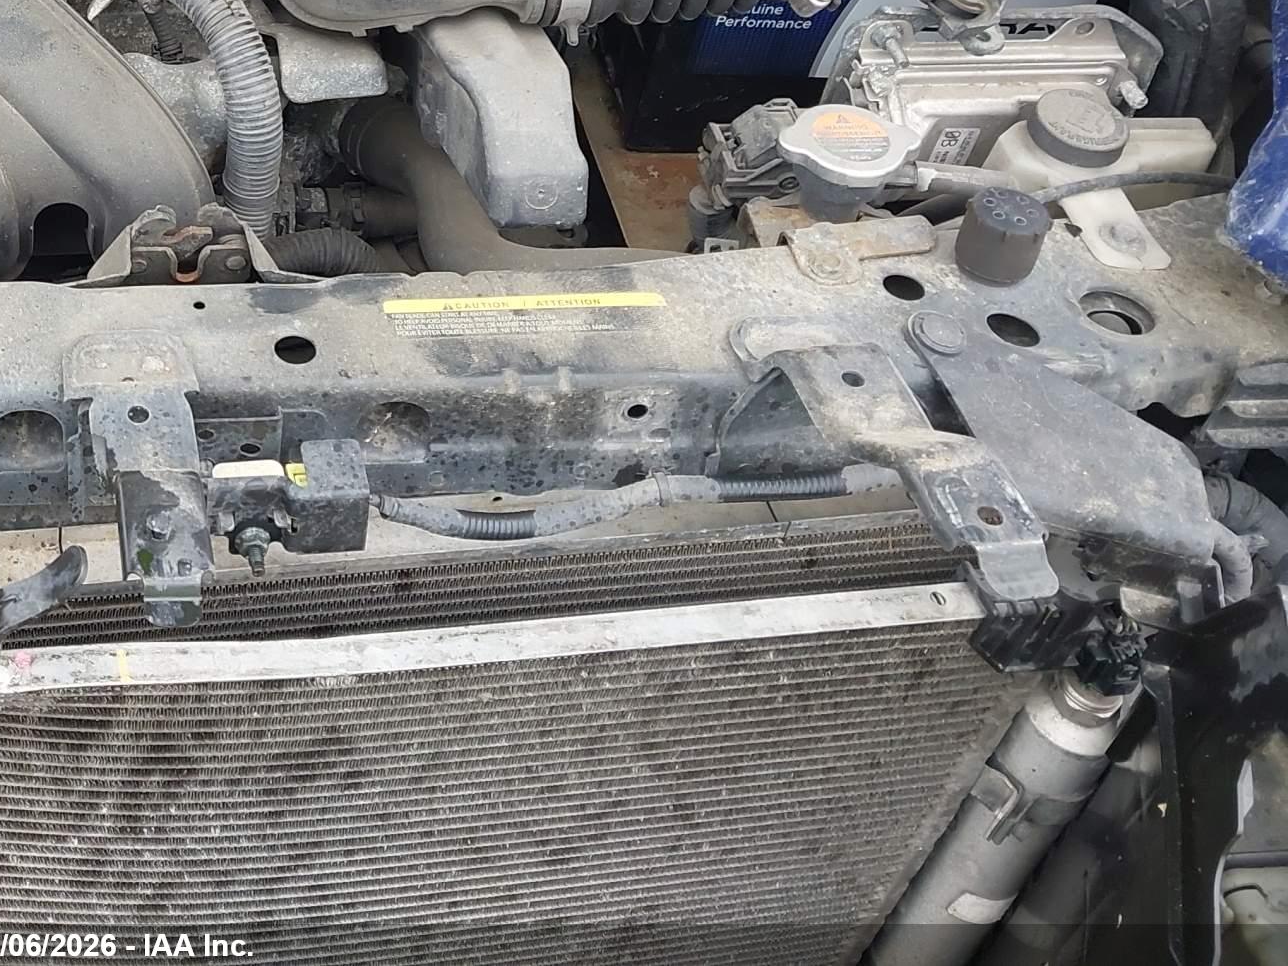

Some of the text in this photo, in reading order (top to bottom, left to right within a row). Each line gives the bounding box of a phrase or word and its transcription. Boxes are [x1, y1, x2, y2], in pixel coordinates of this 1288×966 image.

[715, 15, 812, 29] Performance
[455, 298, 602, 309] CAUTION ATTENTION
